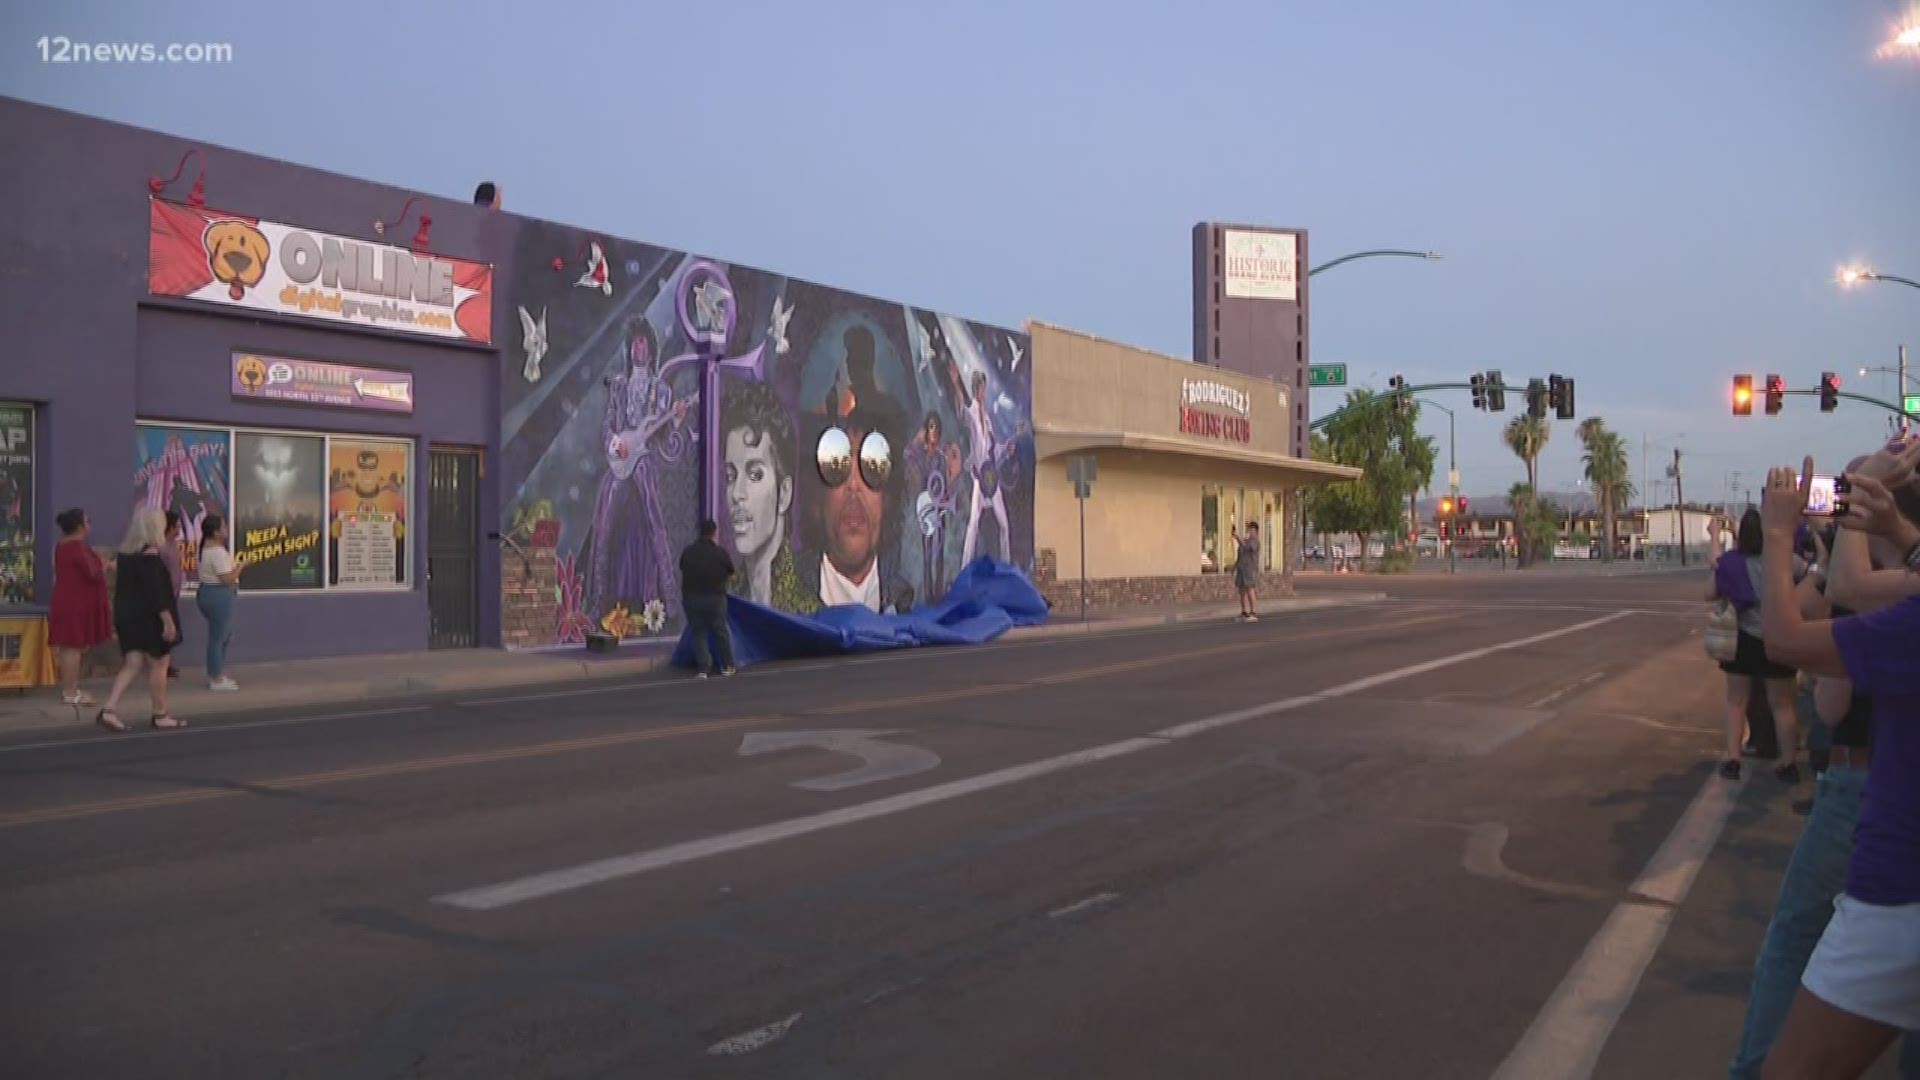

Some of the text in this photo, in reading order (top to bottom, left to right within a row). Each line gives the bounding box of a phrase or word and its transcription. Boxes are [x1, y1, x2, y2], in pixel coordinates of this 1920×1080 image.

[280, 232, 454, 307] ONLINE
[1228, 256, 1292, 273] HISTORIC
[1223, 415, 1250, 443] CLUB
[236, 541, 283, 565] CUSTOM
[284, 530, 320, 553] SIGN?
[245, 524, 288, 546] NEED A
